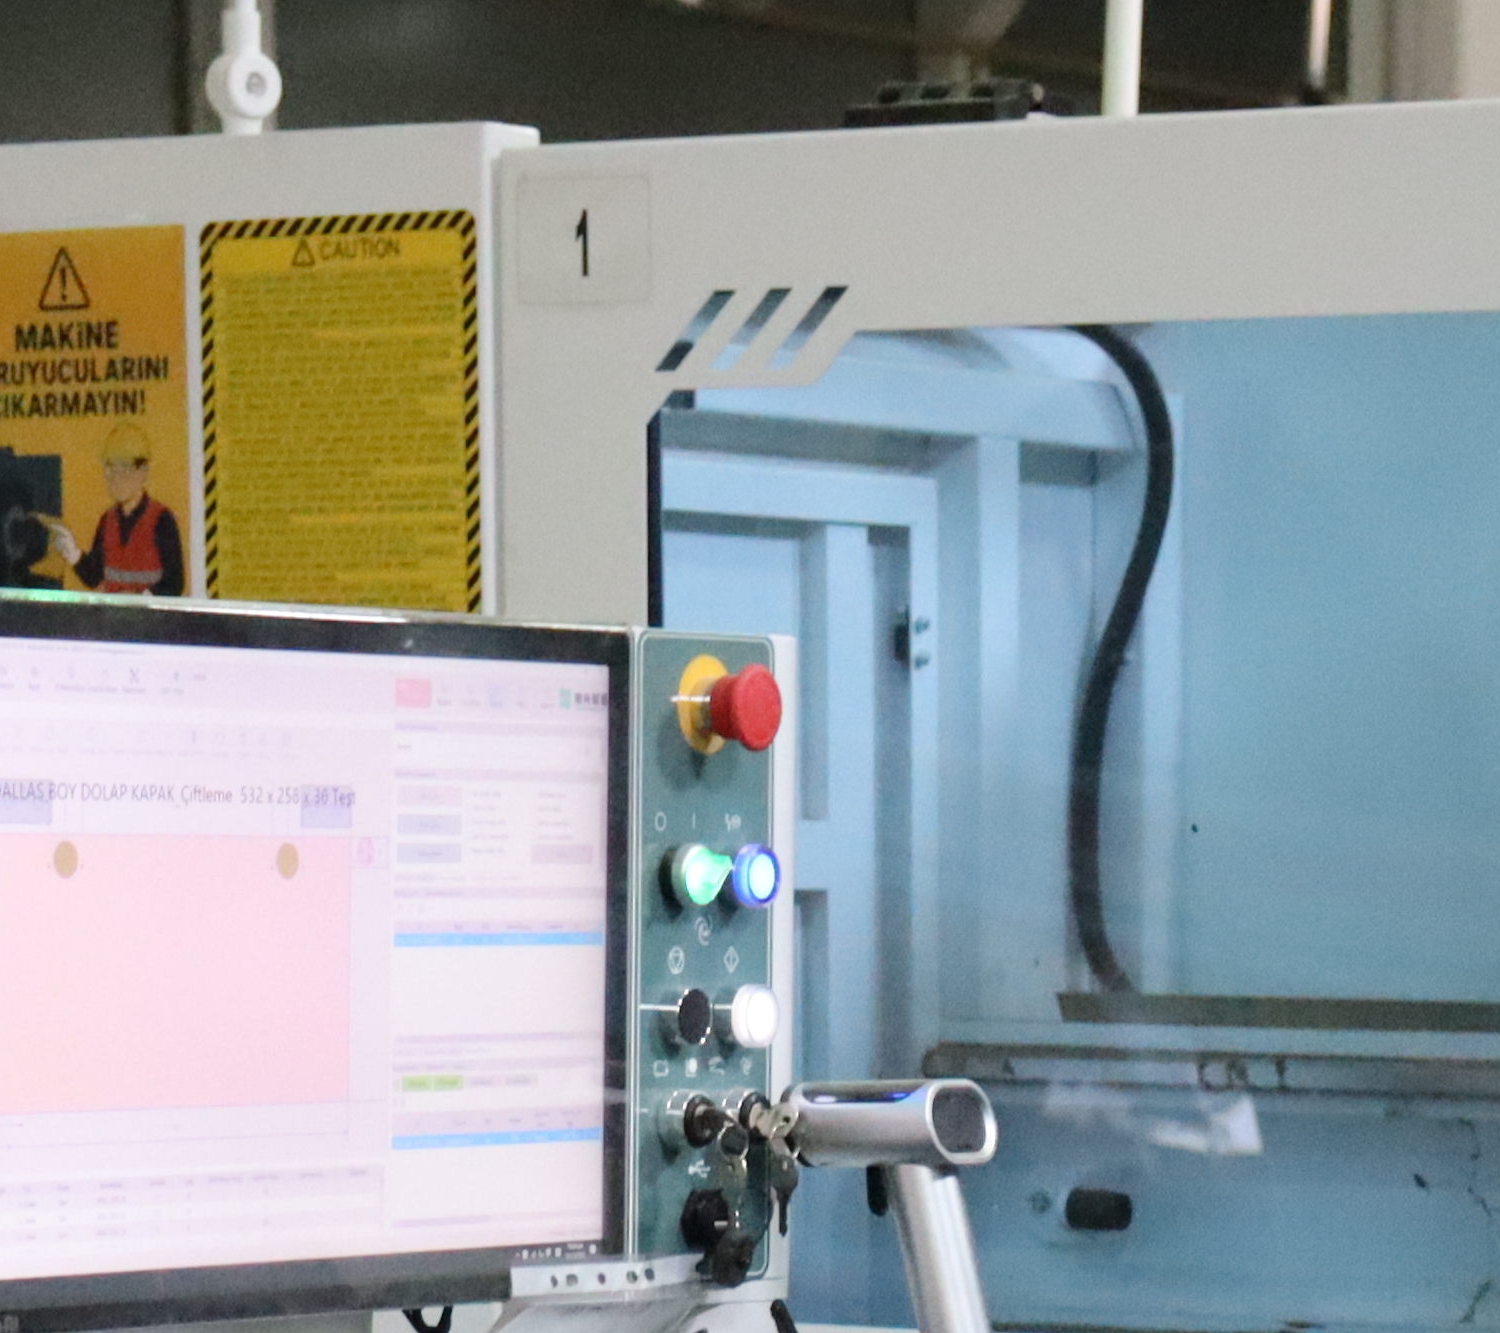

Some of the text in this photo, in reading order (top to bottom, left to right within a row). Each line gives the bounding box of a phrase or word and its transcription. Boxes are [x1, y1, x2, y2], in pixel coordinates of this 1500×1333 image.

[319, 237, 400, 260] CAUTION
[574, 209, 590, 277] 1
[49, 781, 76, 801] BOY
[81, 783, 128, 802] DOLAP
